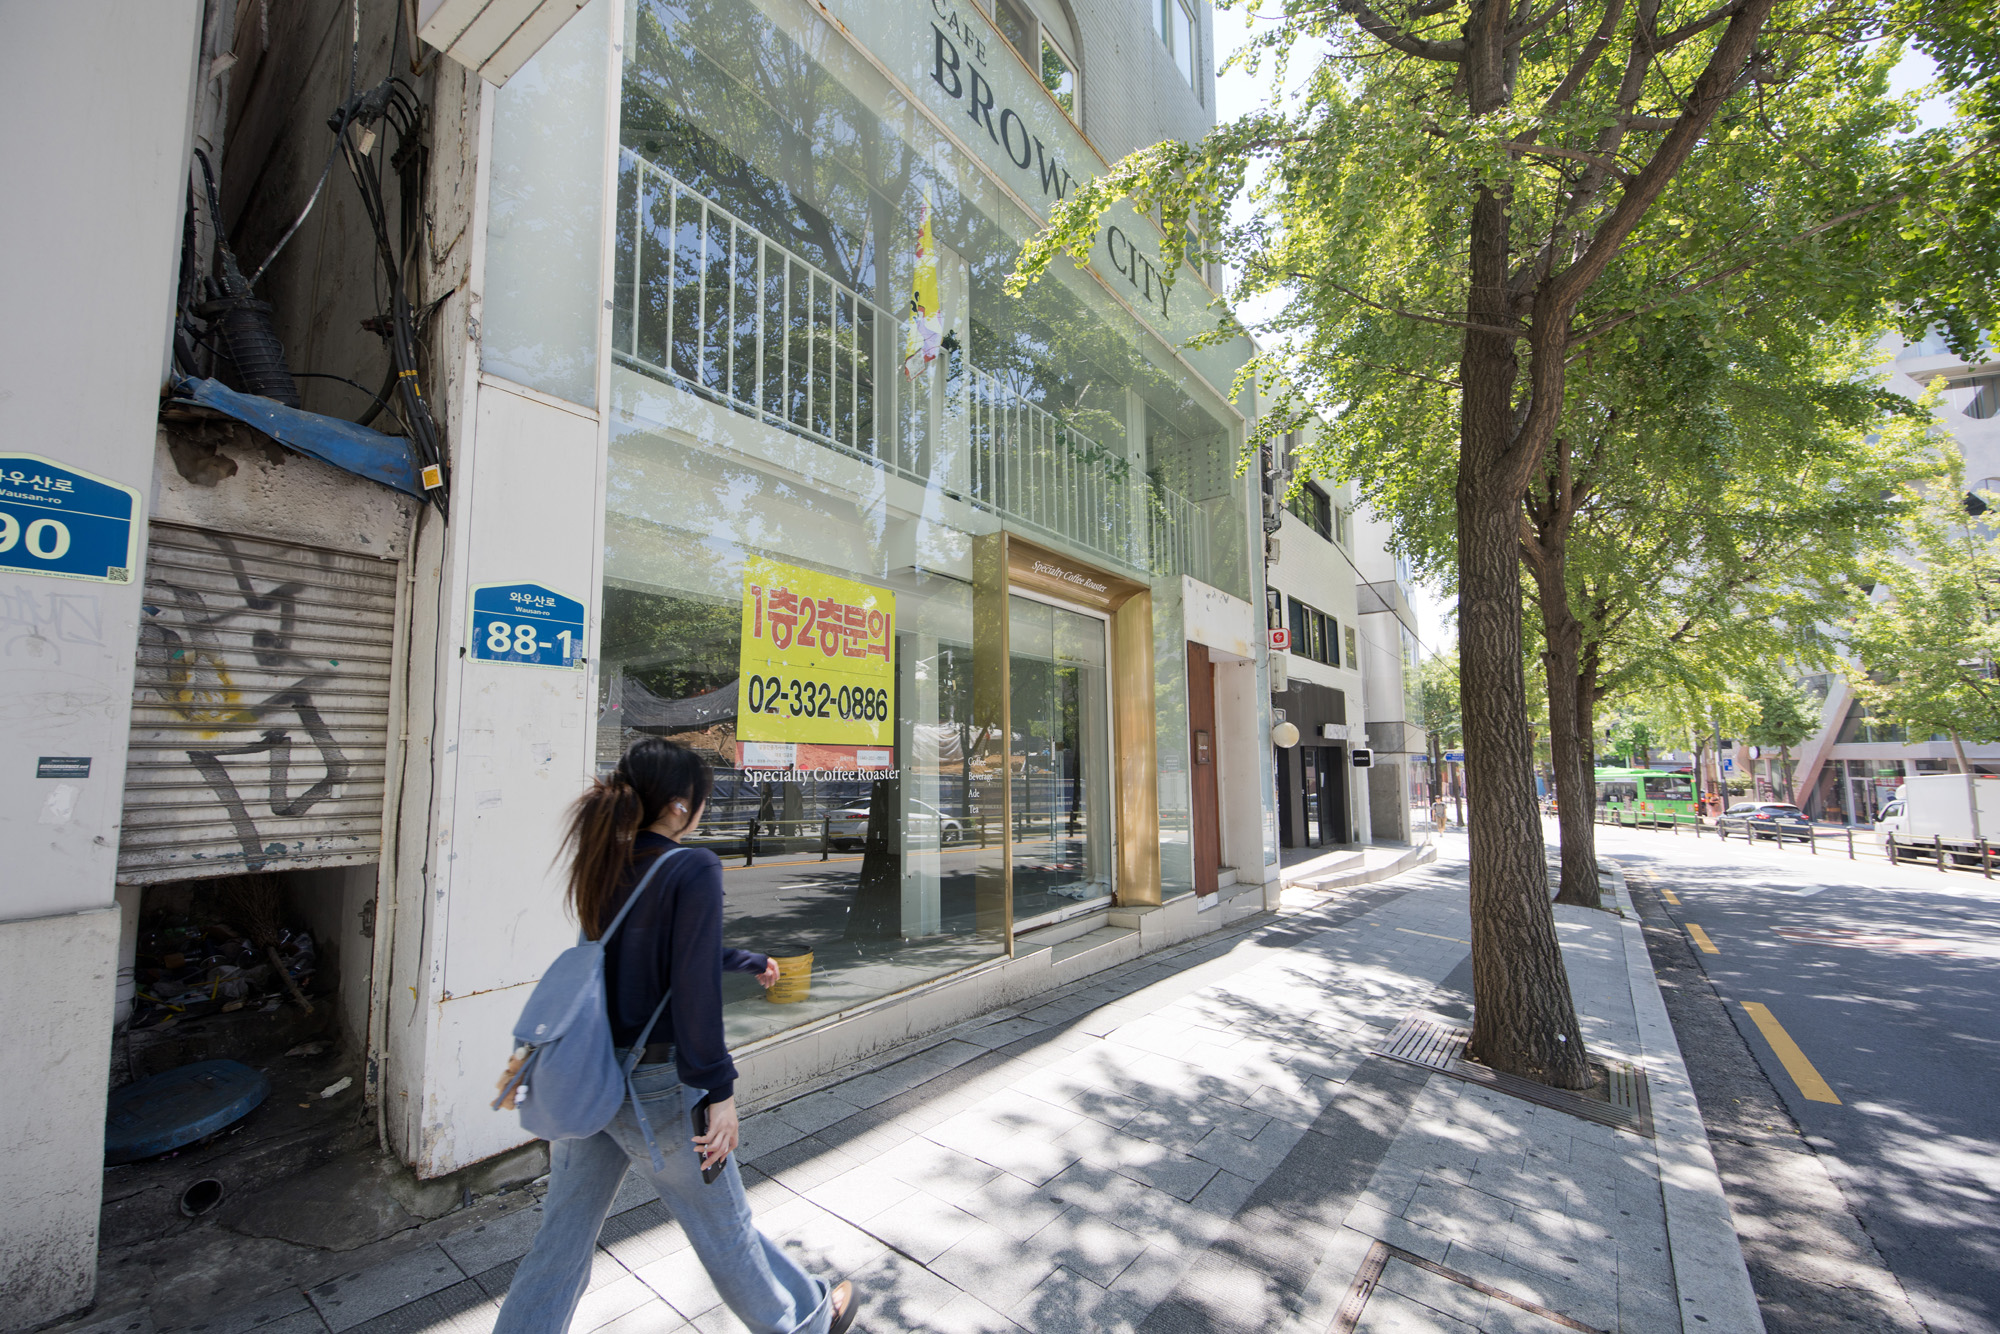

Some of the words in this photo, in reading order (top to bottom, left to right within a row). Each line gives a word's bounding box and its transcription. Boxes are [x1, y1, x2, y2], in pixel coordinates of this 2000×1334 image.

[931, 0, 987, 67] CAFE
[930, 21, 1095, 242] BROW
[1107, 225, 1172, 320] CITY
[1032, 560, 1064, 580] Specialty
[1063, 571, 1085, 585] Coffee
[1083, 578, 1107, 592] Roaster
[509, 592, 556, 608] 와우산로
[515, 606, 550, 616] Wausan-ro
[751, 585, 891, 662] 1층2층문의
[486, 621, 572, 659] 88-1
[748, 674, 888, 722] 02-332-0886
[968, 756, 987, 766] Coffee
[743, 766, 810, 787] Specialty
[813, 766, 855, 782] Coffee
[857, 767, 900, 781] Roaster
[968, 771, 993, 783] Beverage
[968, 788, 980, 798] Ade
[968, 804, 979, 814] Tea
